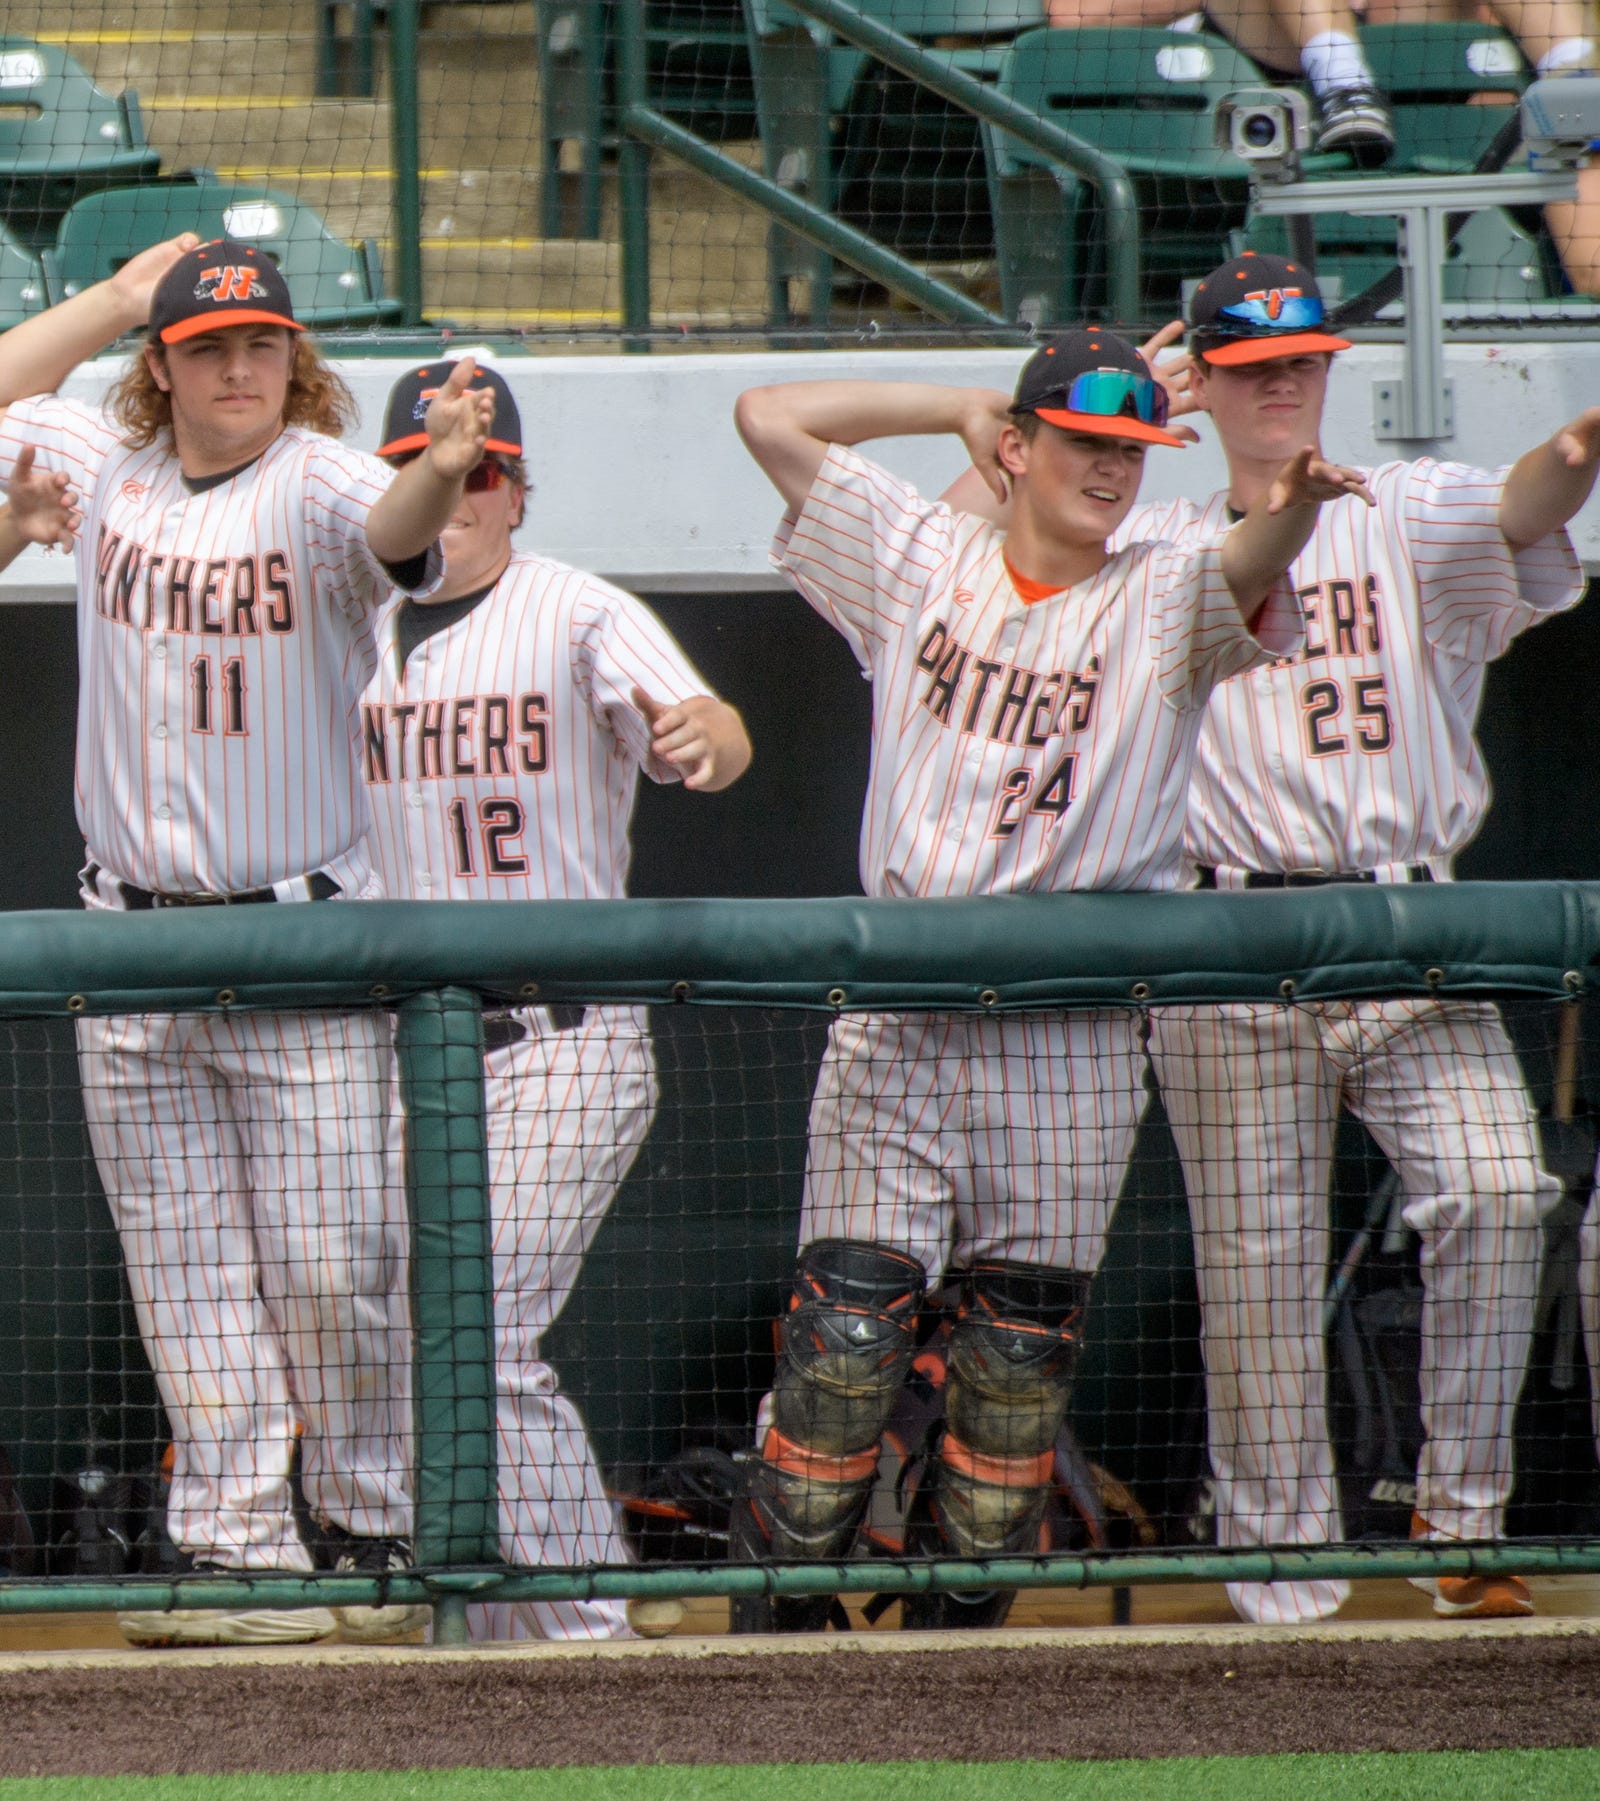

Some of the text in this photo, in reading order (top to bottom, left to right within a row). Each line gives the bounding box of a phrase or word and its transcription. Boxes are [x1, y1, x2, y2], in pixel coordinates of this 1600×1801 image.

[190, 654, 250, 736] 11
[360, 691, 551, 784] NTHERS
[1300, 673, 1394, 759] 25
[448, 796, 531, 878] 12
[988, 752, 1081, 840] 24
